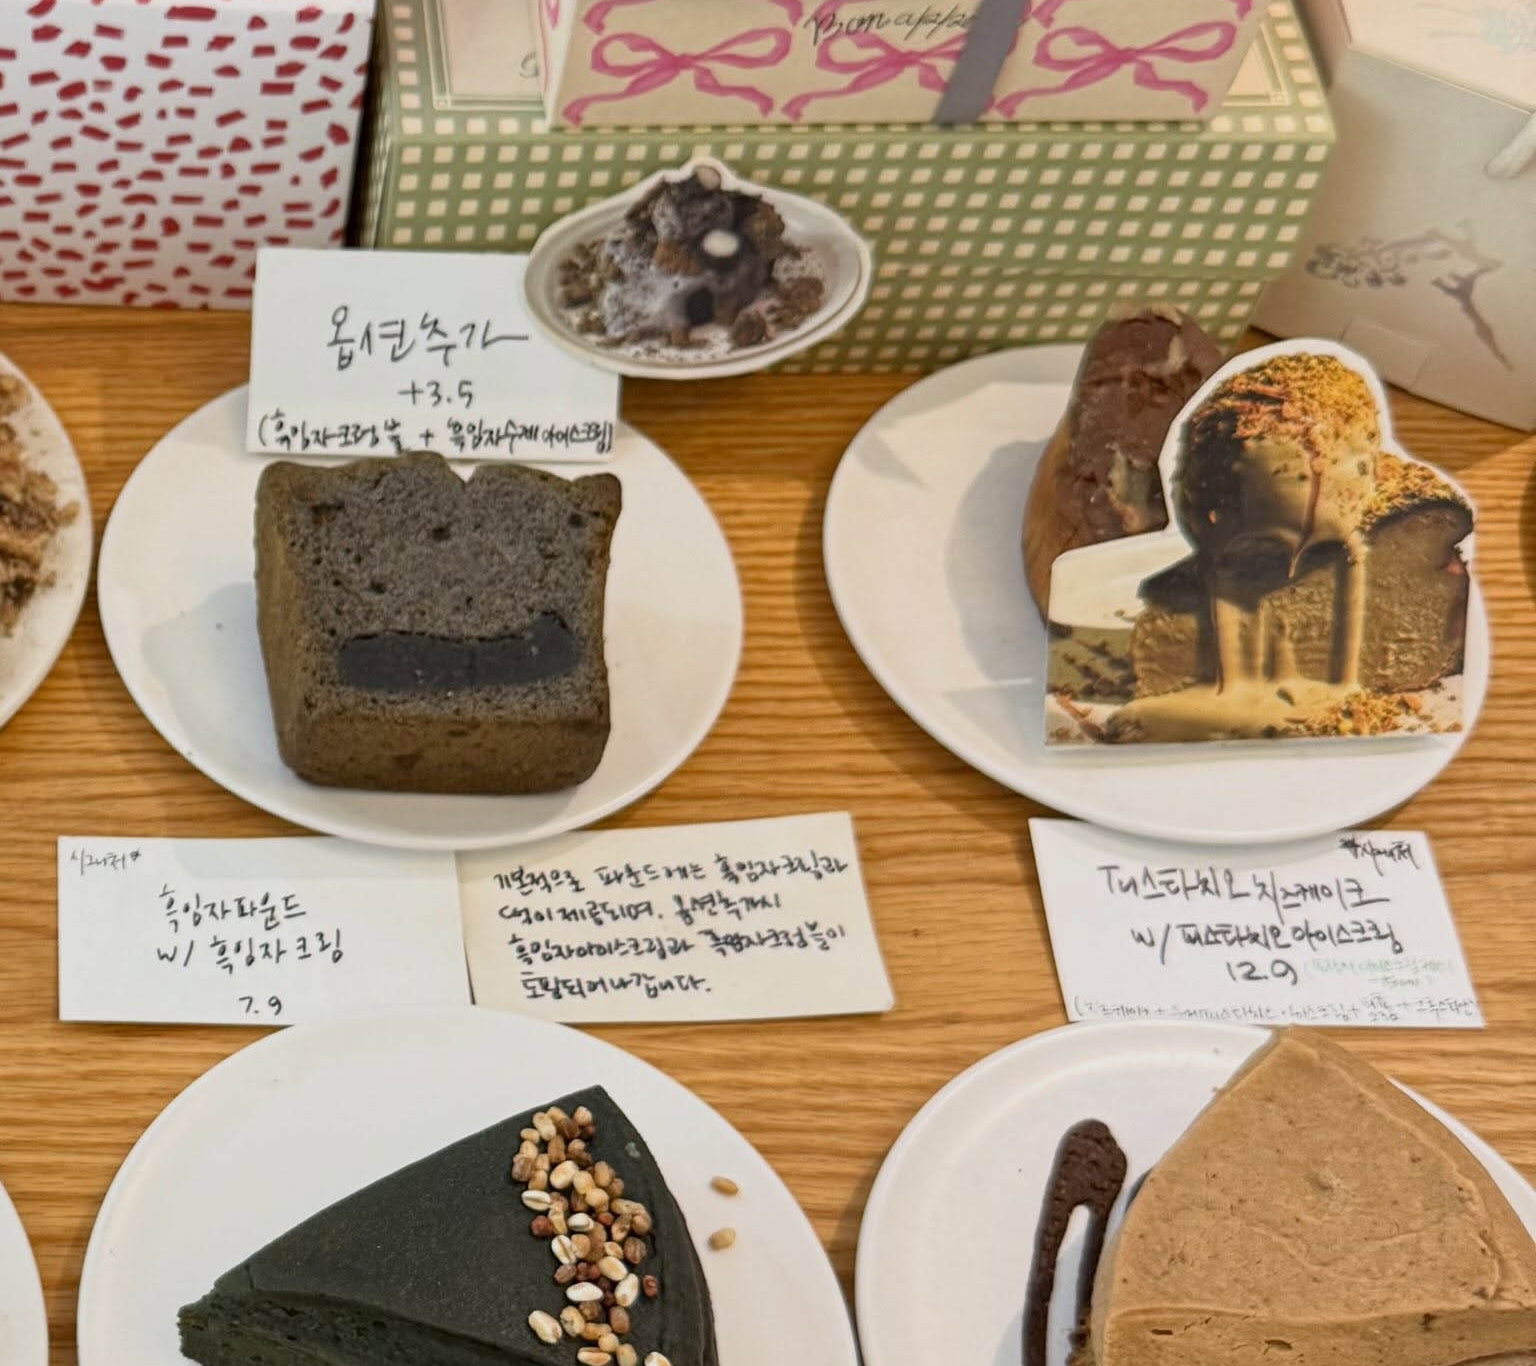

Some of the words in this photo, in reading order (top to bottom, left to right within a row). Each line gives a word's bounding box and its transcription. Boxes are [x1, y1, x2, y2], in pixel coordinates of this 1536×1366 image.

[398, 379, 474, 409] +3.5
[1227, 959, 1298, 987] 12.9
[238, 995, 283, 1016] 7.9
